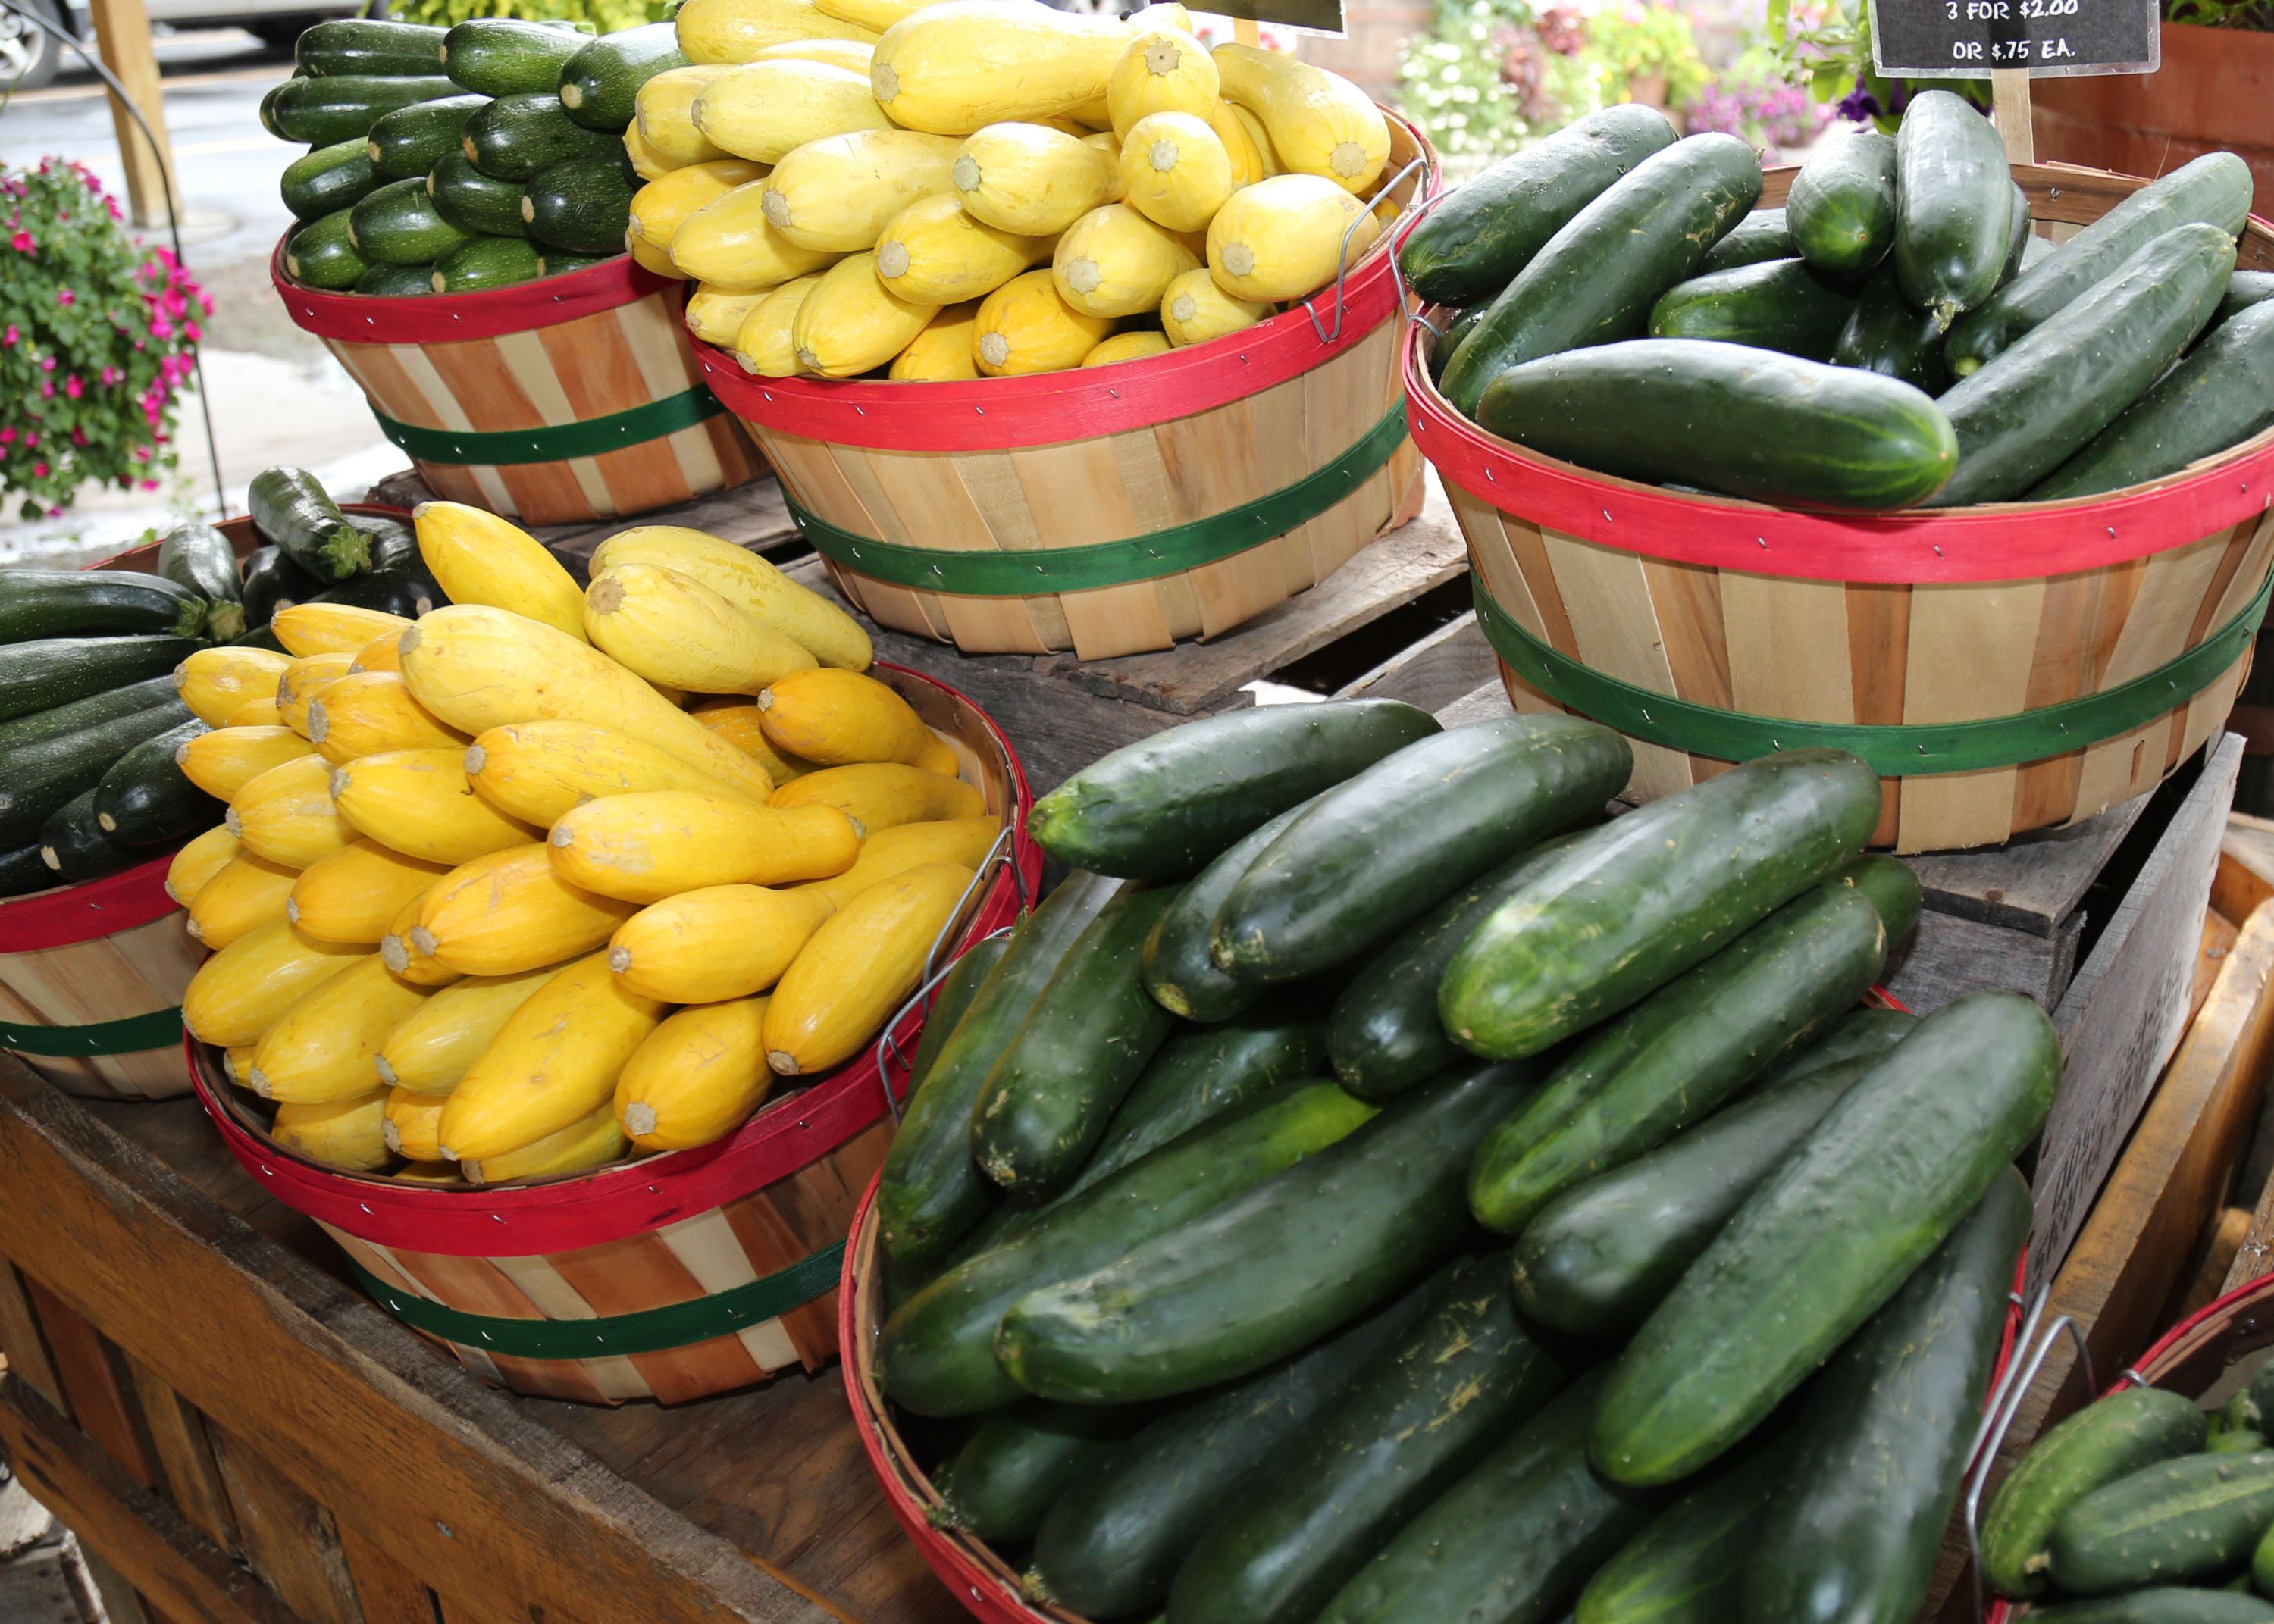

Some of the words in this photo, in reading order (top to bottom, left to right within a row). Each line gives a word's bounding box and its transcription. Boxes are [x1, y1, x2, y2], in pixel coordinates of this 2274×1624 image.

[1946, 1, 1958, 20] 3
[1966, 1, 2010, 20] FOR
[2019, 0, 2078, 19] $2.00
[1953, 42, 1984, 60] OR
[1991, 41, 2031, 61] $.75
[2041, 38, 2076, 58] EA.
